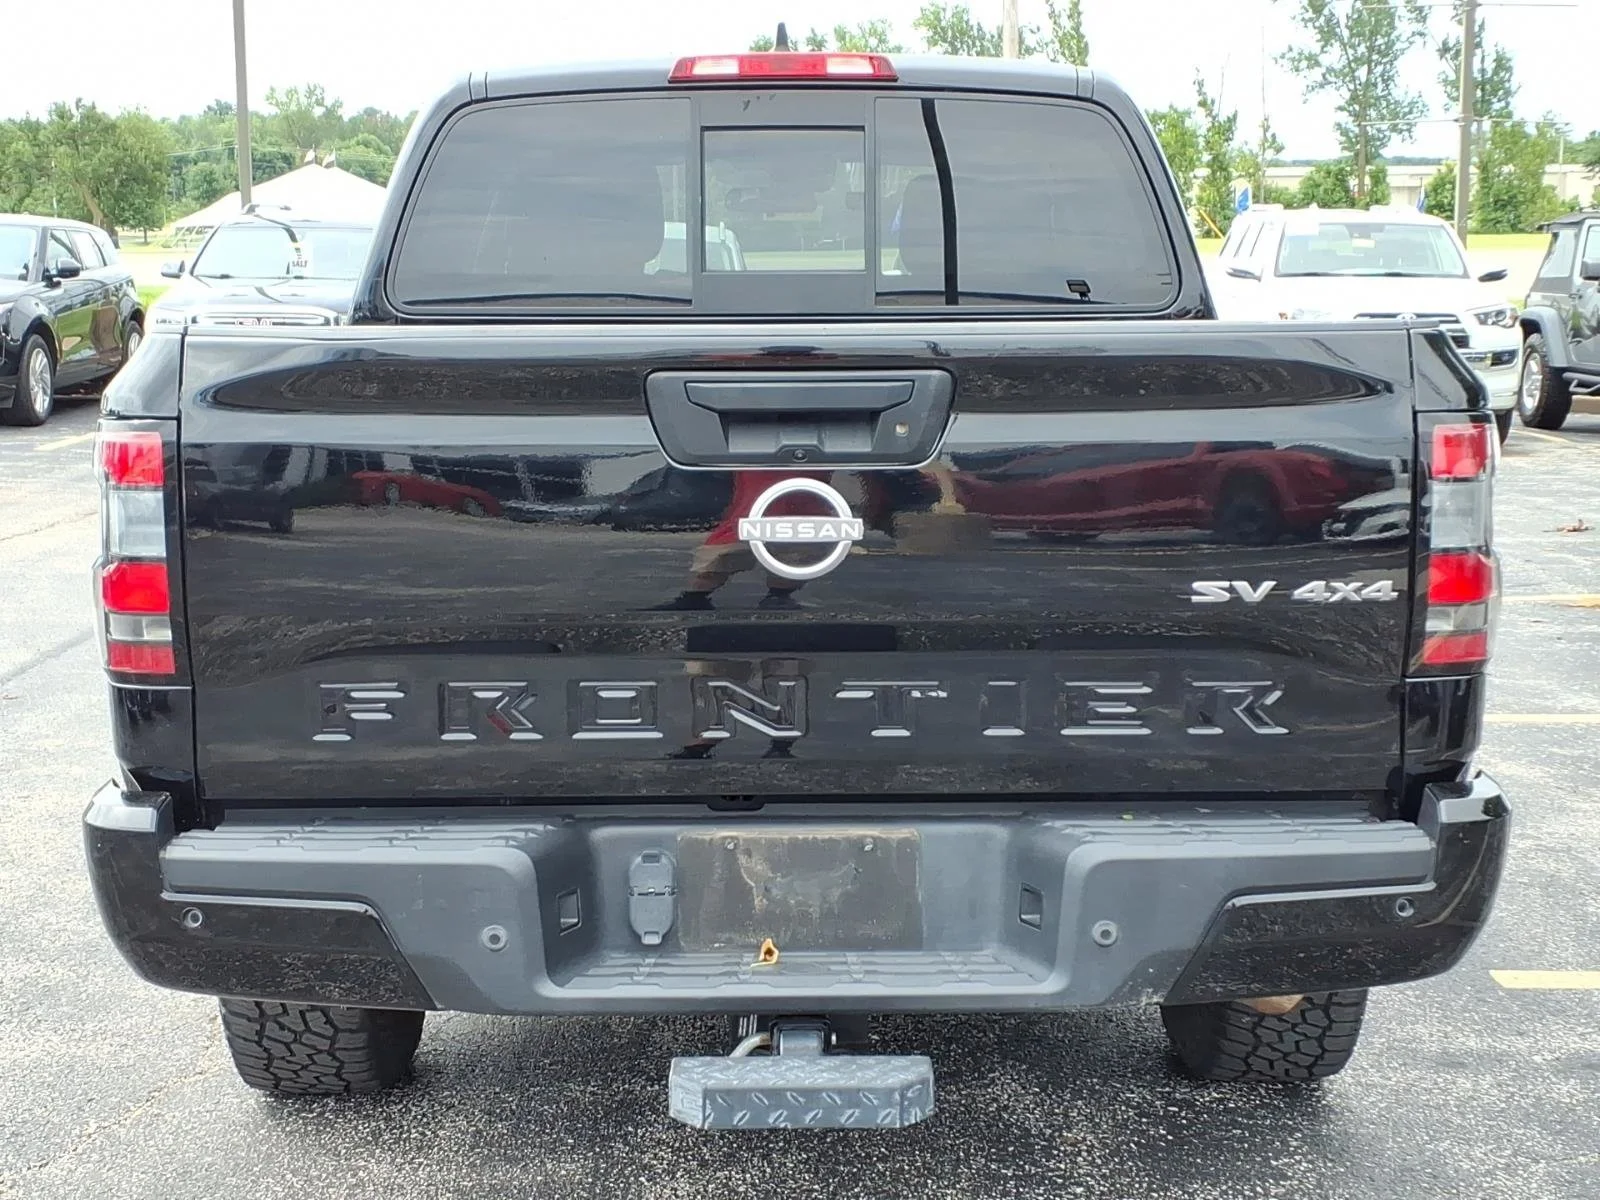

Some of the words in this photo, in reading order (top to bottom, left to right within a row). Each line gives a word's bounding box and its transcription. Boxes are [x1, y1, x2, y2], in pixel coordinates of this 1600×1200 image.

[742, 522, 860, 539] NISSAN
[1190, 580, 1277, 603] SV
[312, 680, 1290, 742] FRONTIER
